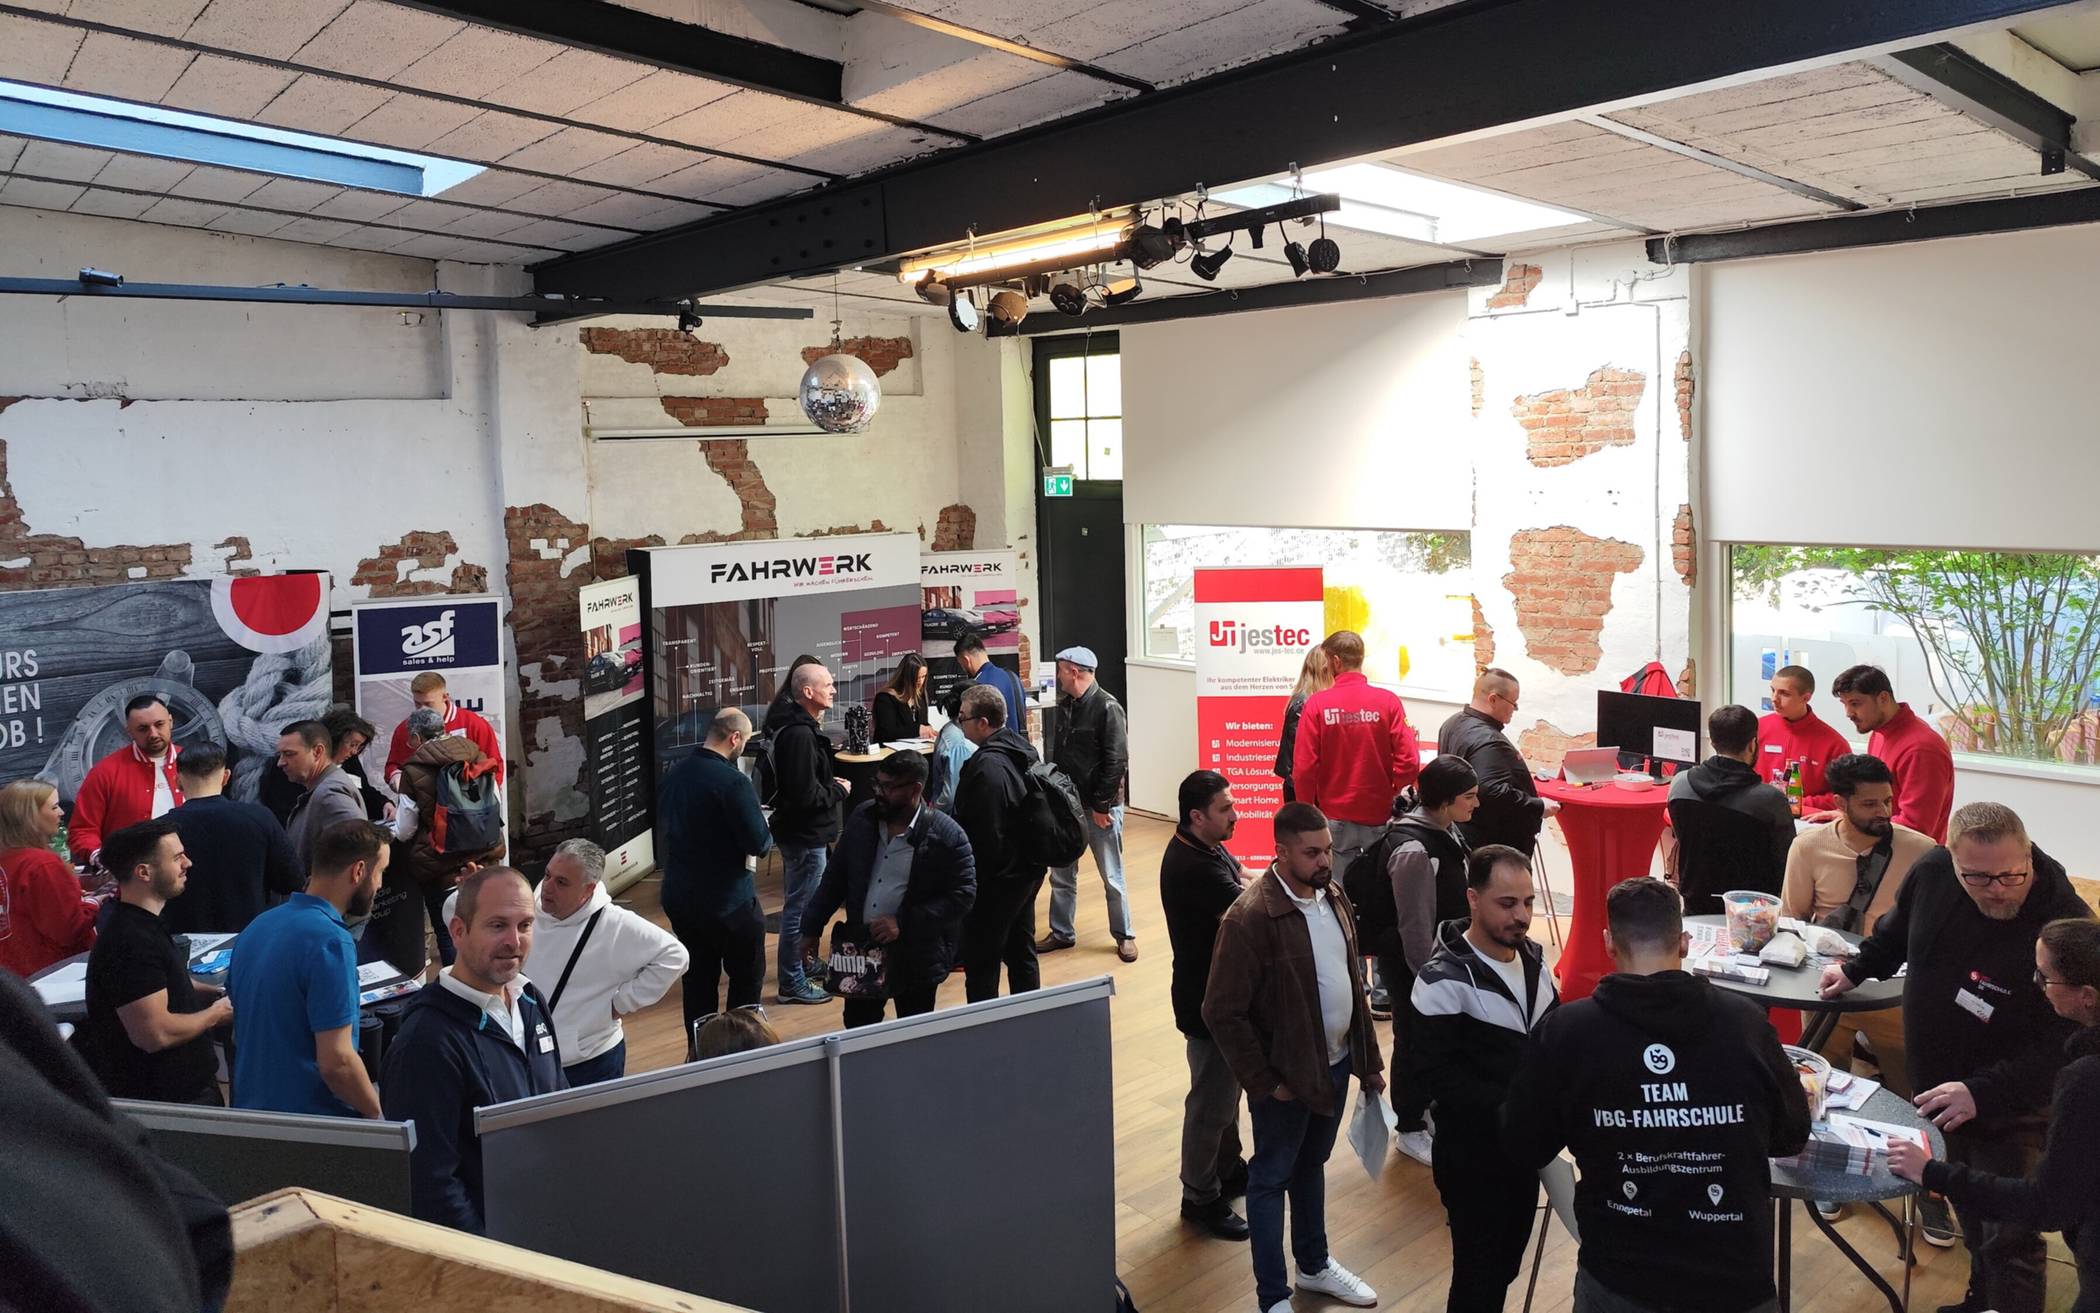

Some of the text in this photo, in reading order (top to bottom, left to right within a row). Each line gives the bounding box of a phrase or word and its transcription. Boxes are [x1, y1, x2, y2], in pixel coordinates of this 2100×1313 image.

[711, 553, 872, 584] FAHRWERK
[921, 562, 1002, 575] FAHRWERK
[587, 592, 633, 613] FAHRWERK
[401, 609, 455, 655] asf
[1240, 623, 1311, 654] jestec
[662, 638, 697, 646] TRANSPARENT
[0, 649, 39, 679] RS
[0, 683, 41, 714] EN
[1225, 722, 1274, 731] Wir bieten:
[1227, 767, 1244, 776] TGA
[1253, 796, 1280, 805] Home
[1641, 1082, 1688, 1103] TEAM
[1594, 1104, 1745, 1128] VBG-FAHRSCHULE
[1617, 1151, 1625, 1160] 2
[1635, 1151, 1726, 1163] Berufskraftfahrer-
[1622, 1163, 1723, 1174] Ausbildungszentrum
[1607, 1200, 1652, 1217] Ennepetal
[1689, 1210, 1743, 1222] Wuppertal
